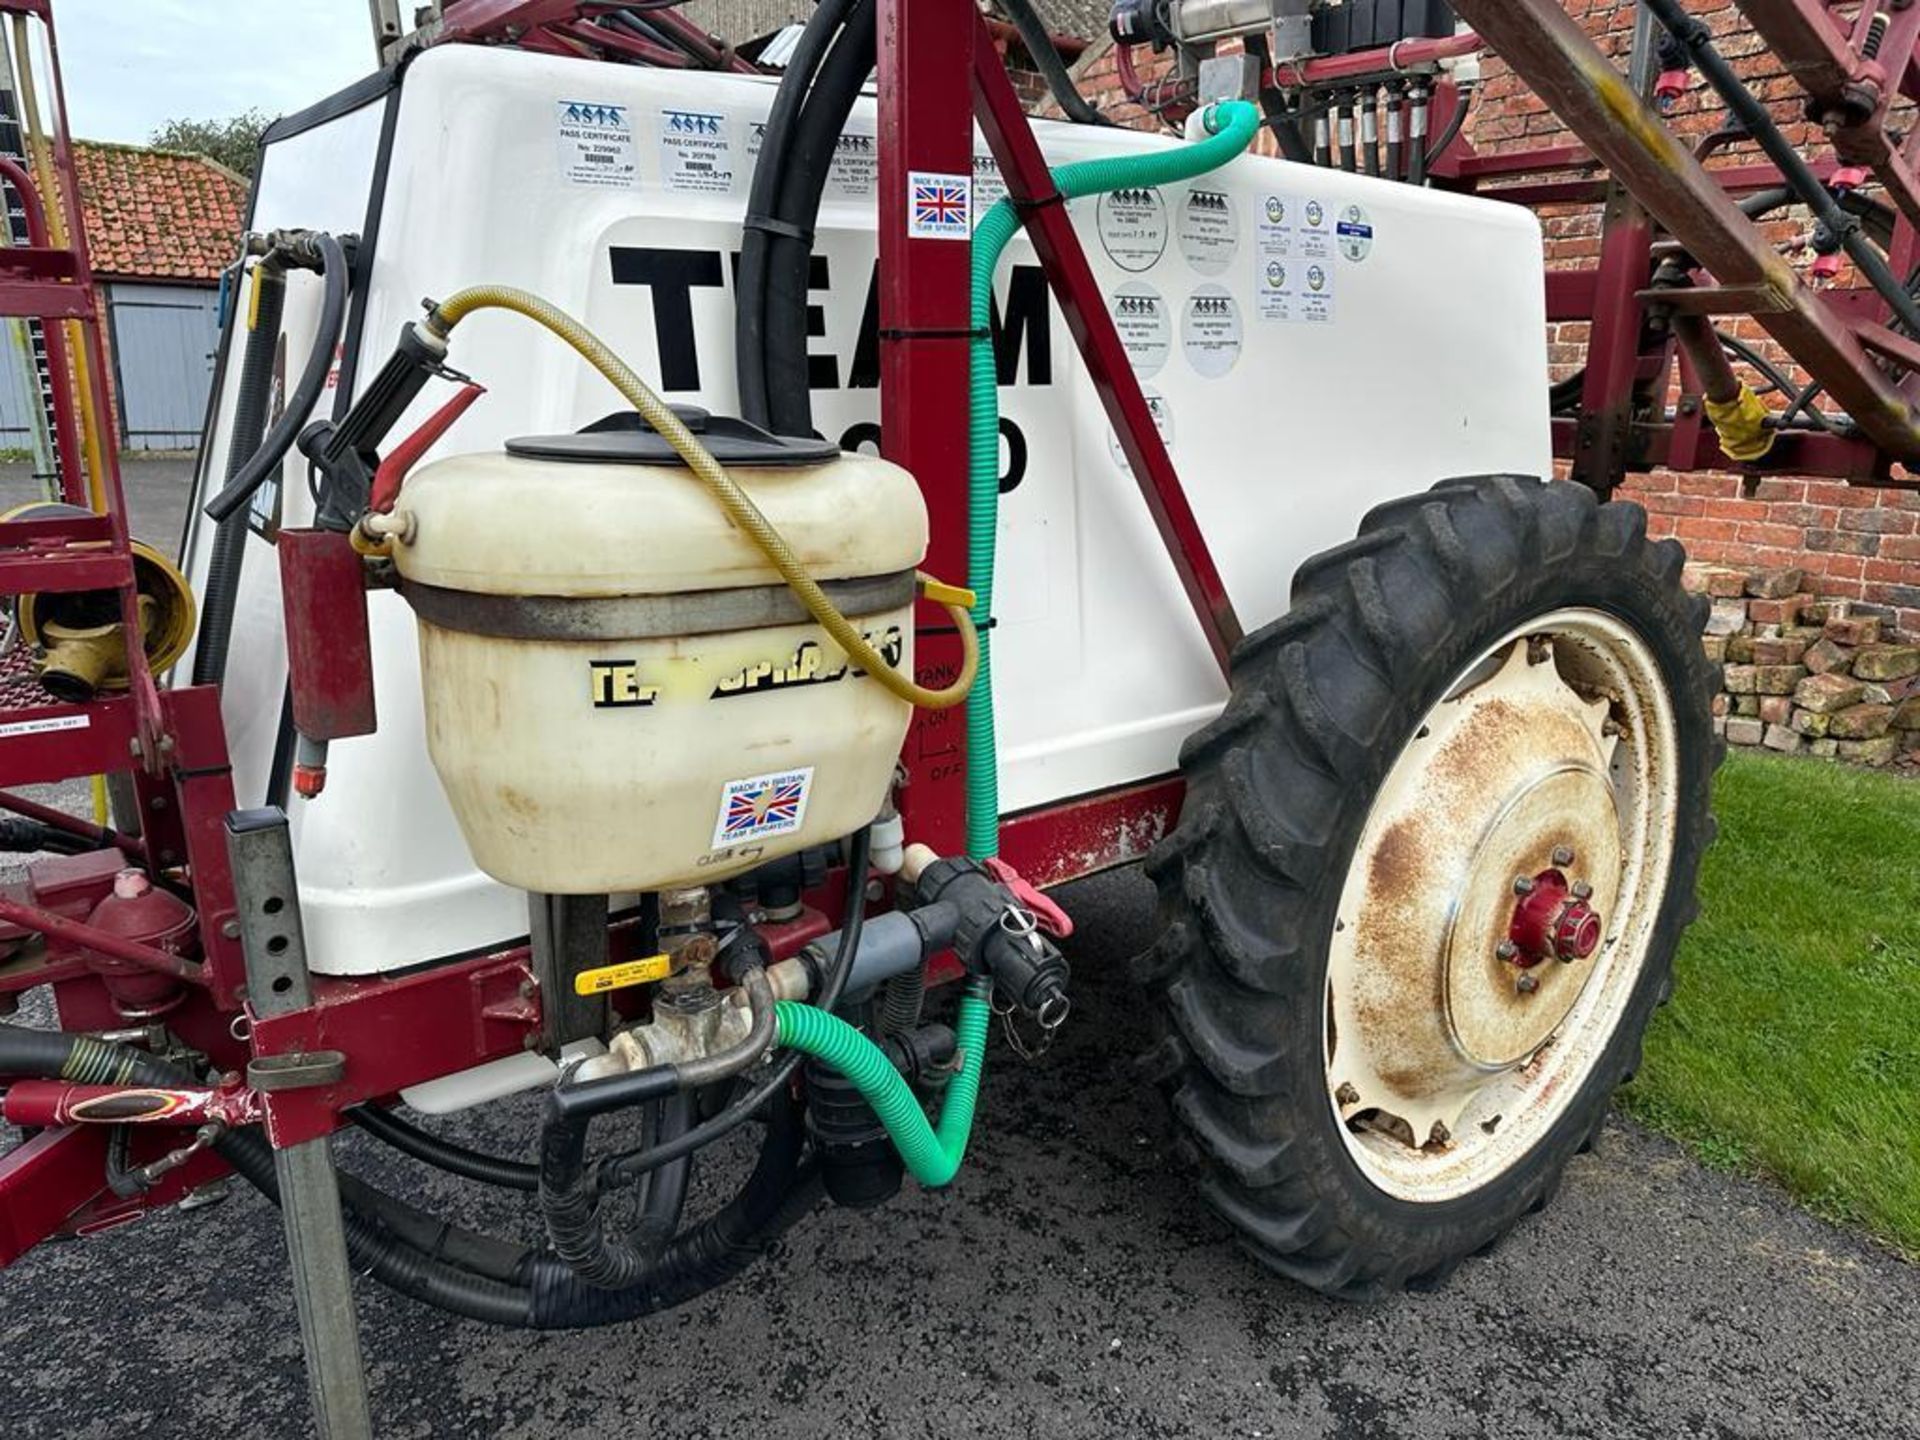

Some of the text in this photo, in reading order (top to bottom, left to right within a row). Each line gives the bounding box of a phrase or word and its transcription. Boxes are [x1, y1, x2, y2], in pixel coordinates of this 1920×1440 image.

[560, 128, 631, 143] PASS CERTIFICATE
[663, 137, 729, 150] PASS CERTIFICATE
[943, 179, 967, 188] BRITAIN
[609, 246, 1052, 393] TM
[729, 774, 806, 794] MADE IN BRITAIN
[721, 820, 796, 841] TEAM SPRAYERS
